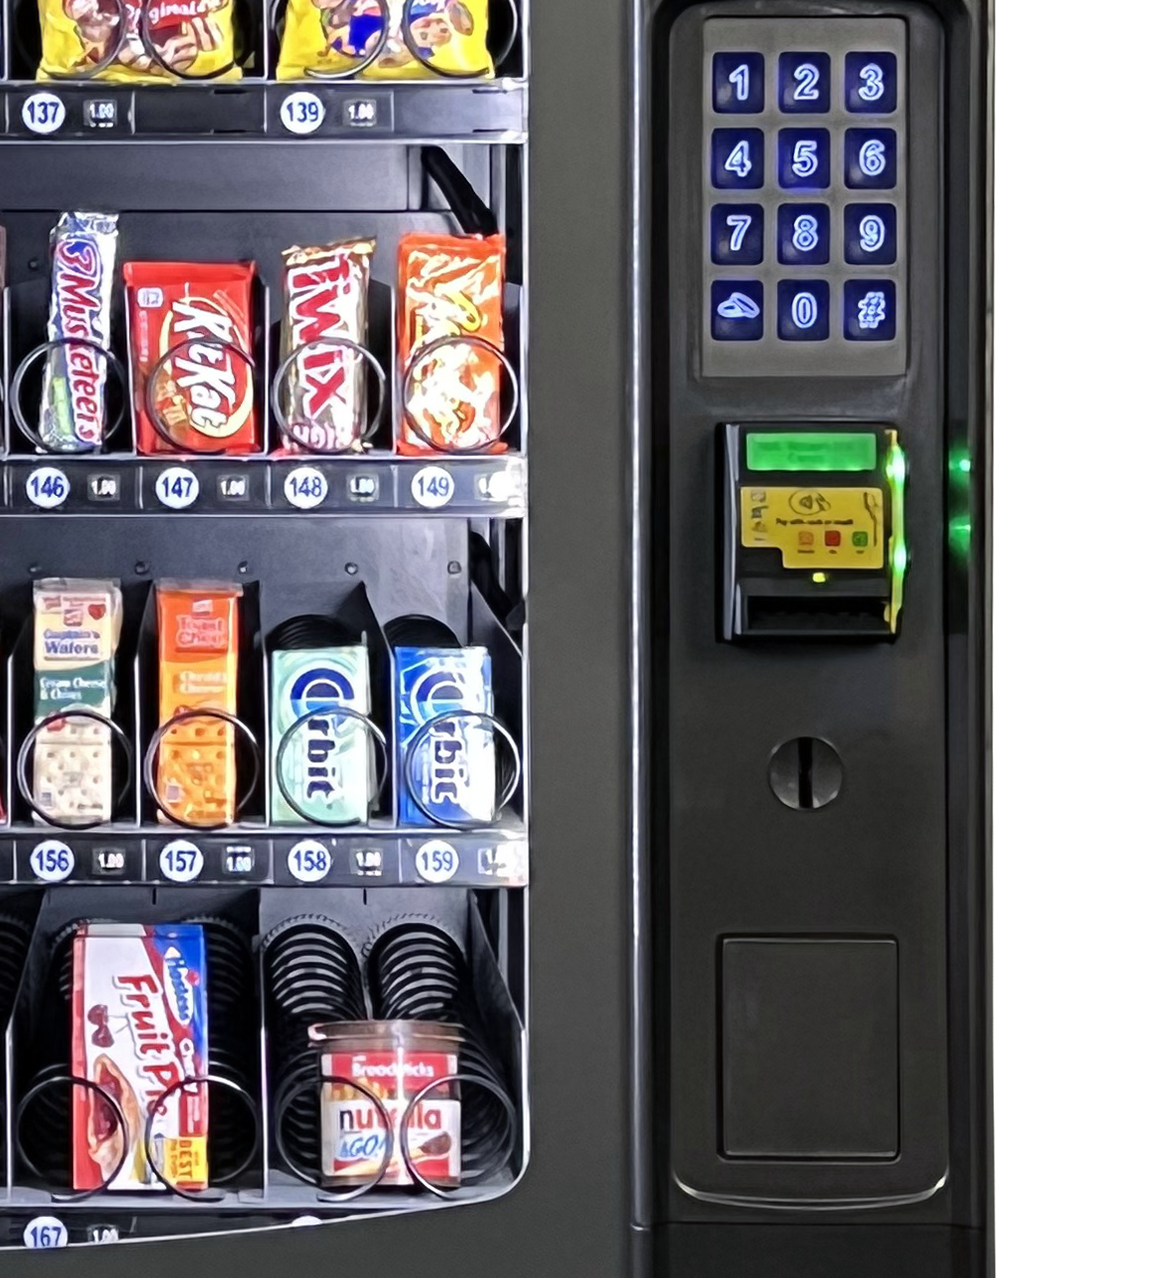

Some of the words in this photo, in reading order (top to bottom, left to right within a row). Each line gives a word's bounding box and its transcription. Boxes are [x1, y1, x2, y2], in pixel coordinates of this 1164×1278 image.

[729, 64, 749, 100] 1
[793, 63, 819, 100] 2
[858, 63, 884, 101] 3
[27, 101, 59, 124] 137
[287, 101, 318, 122] 139
[725, 140, 752, 177] 4
[792, 140, 818, 177] 5
[859, 139, 885, 176] 6
[726, 215, 752, 251] 7
[792, 214, 819, 251] 8
[859, 214, 885, 252] 9
[791, 292, 818, 329] 0
[31, 475, 63, 498] 146
[162, 476, 193, 497] 147
[289, 477, 322, 497] 148
[418, 477, 449, 497] 149
[36, 850, 68, 872] 156
[165, 850, 196, 871] 157
[294, 850, 326, 871] 158
[423, 850, 453, 872] 159
[118, 975, 174, 1061] Fruit
[31, 1227, 62, 1248] 167
